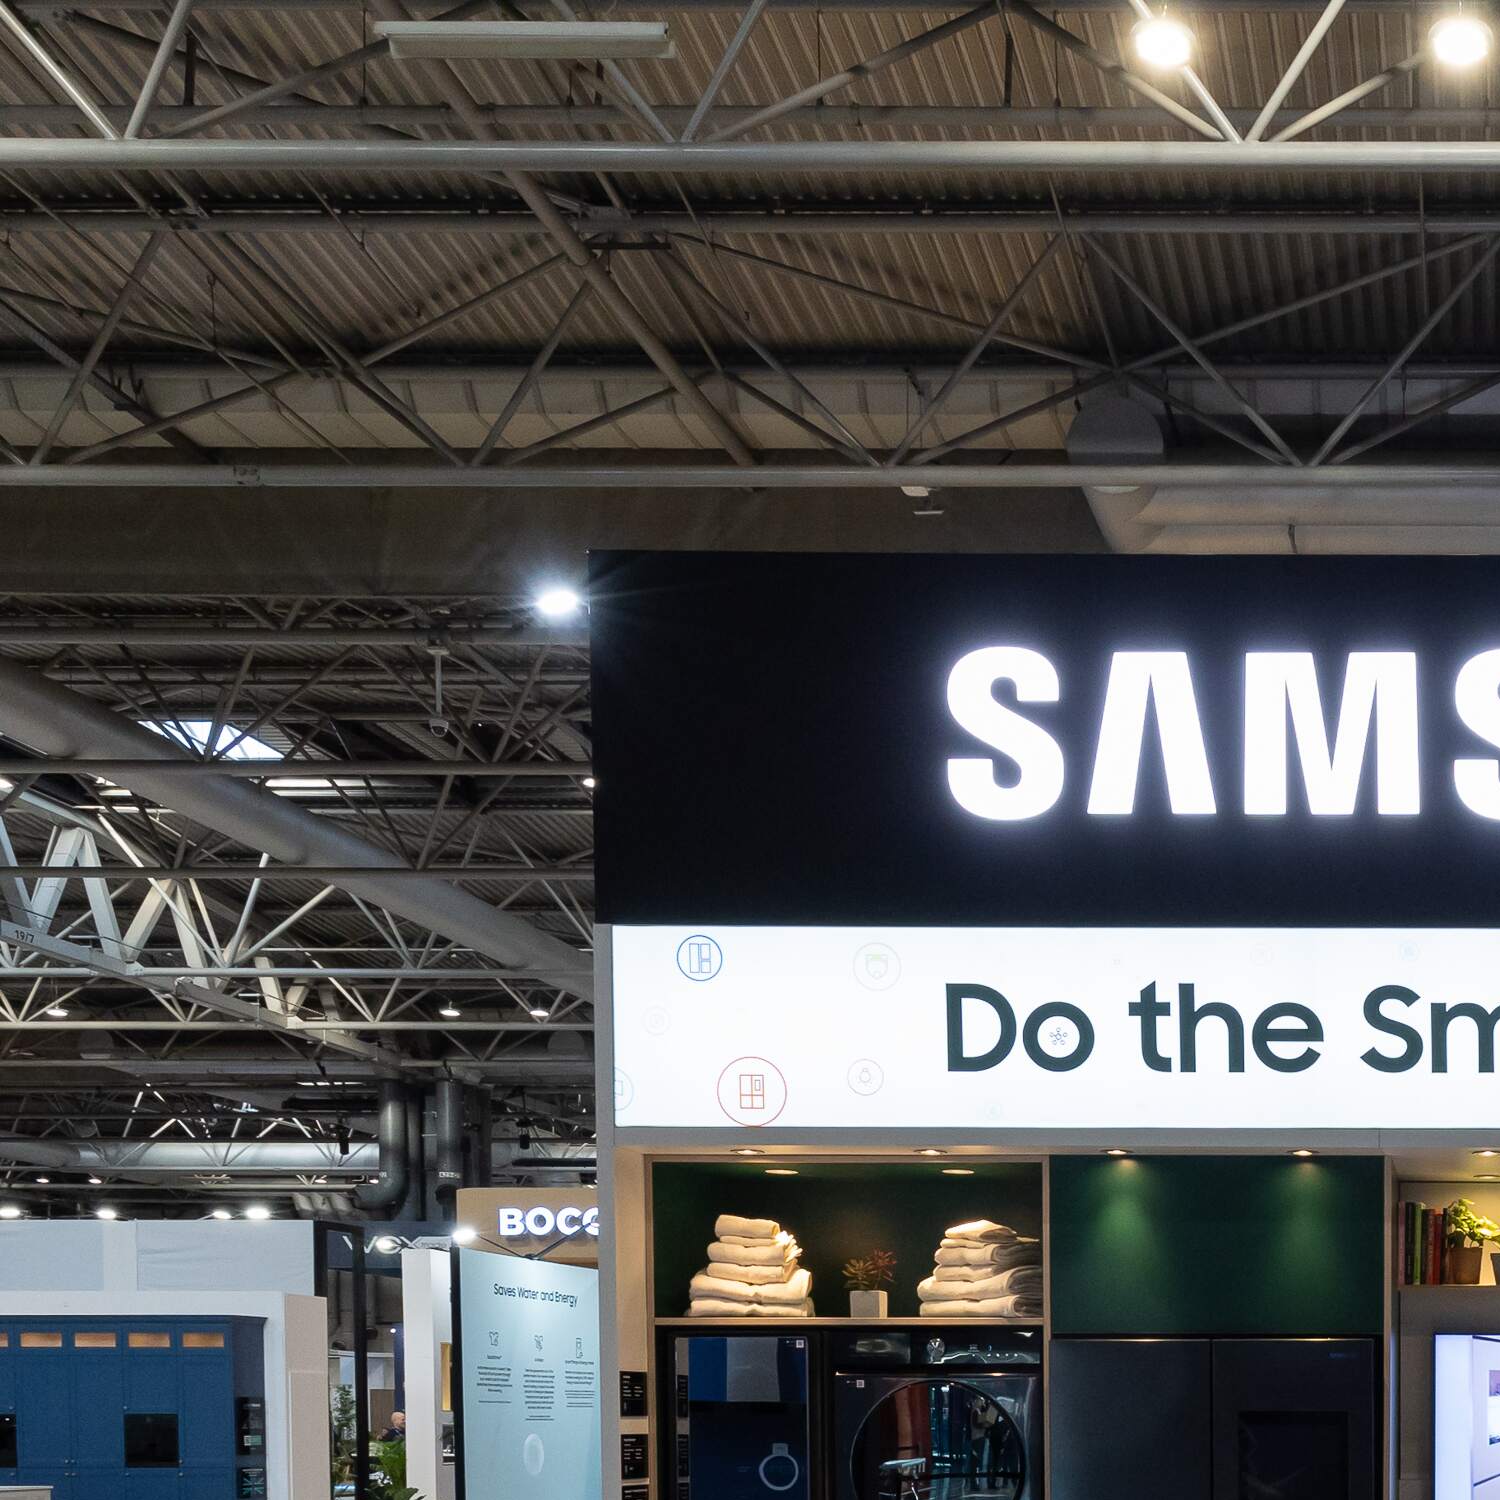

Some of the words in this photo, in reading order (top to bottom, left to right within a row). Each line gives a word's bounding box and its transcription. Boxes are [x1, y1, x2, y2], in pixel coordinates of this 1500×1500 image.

[945, 983, 1096, 1074] Do
[1128, 980, 1326, 1074] the
[493, 1283, 517, 1298] Saves
[516, 1287, 540, 1300] Water
[540, 1289, 554, 1303] and
[555, 1291, 578, 1307] Energy
